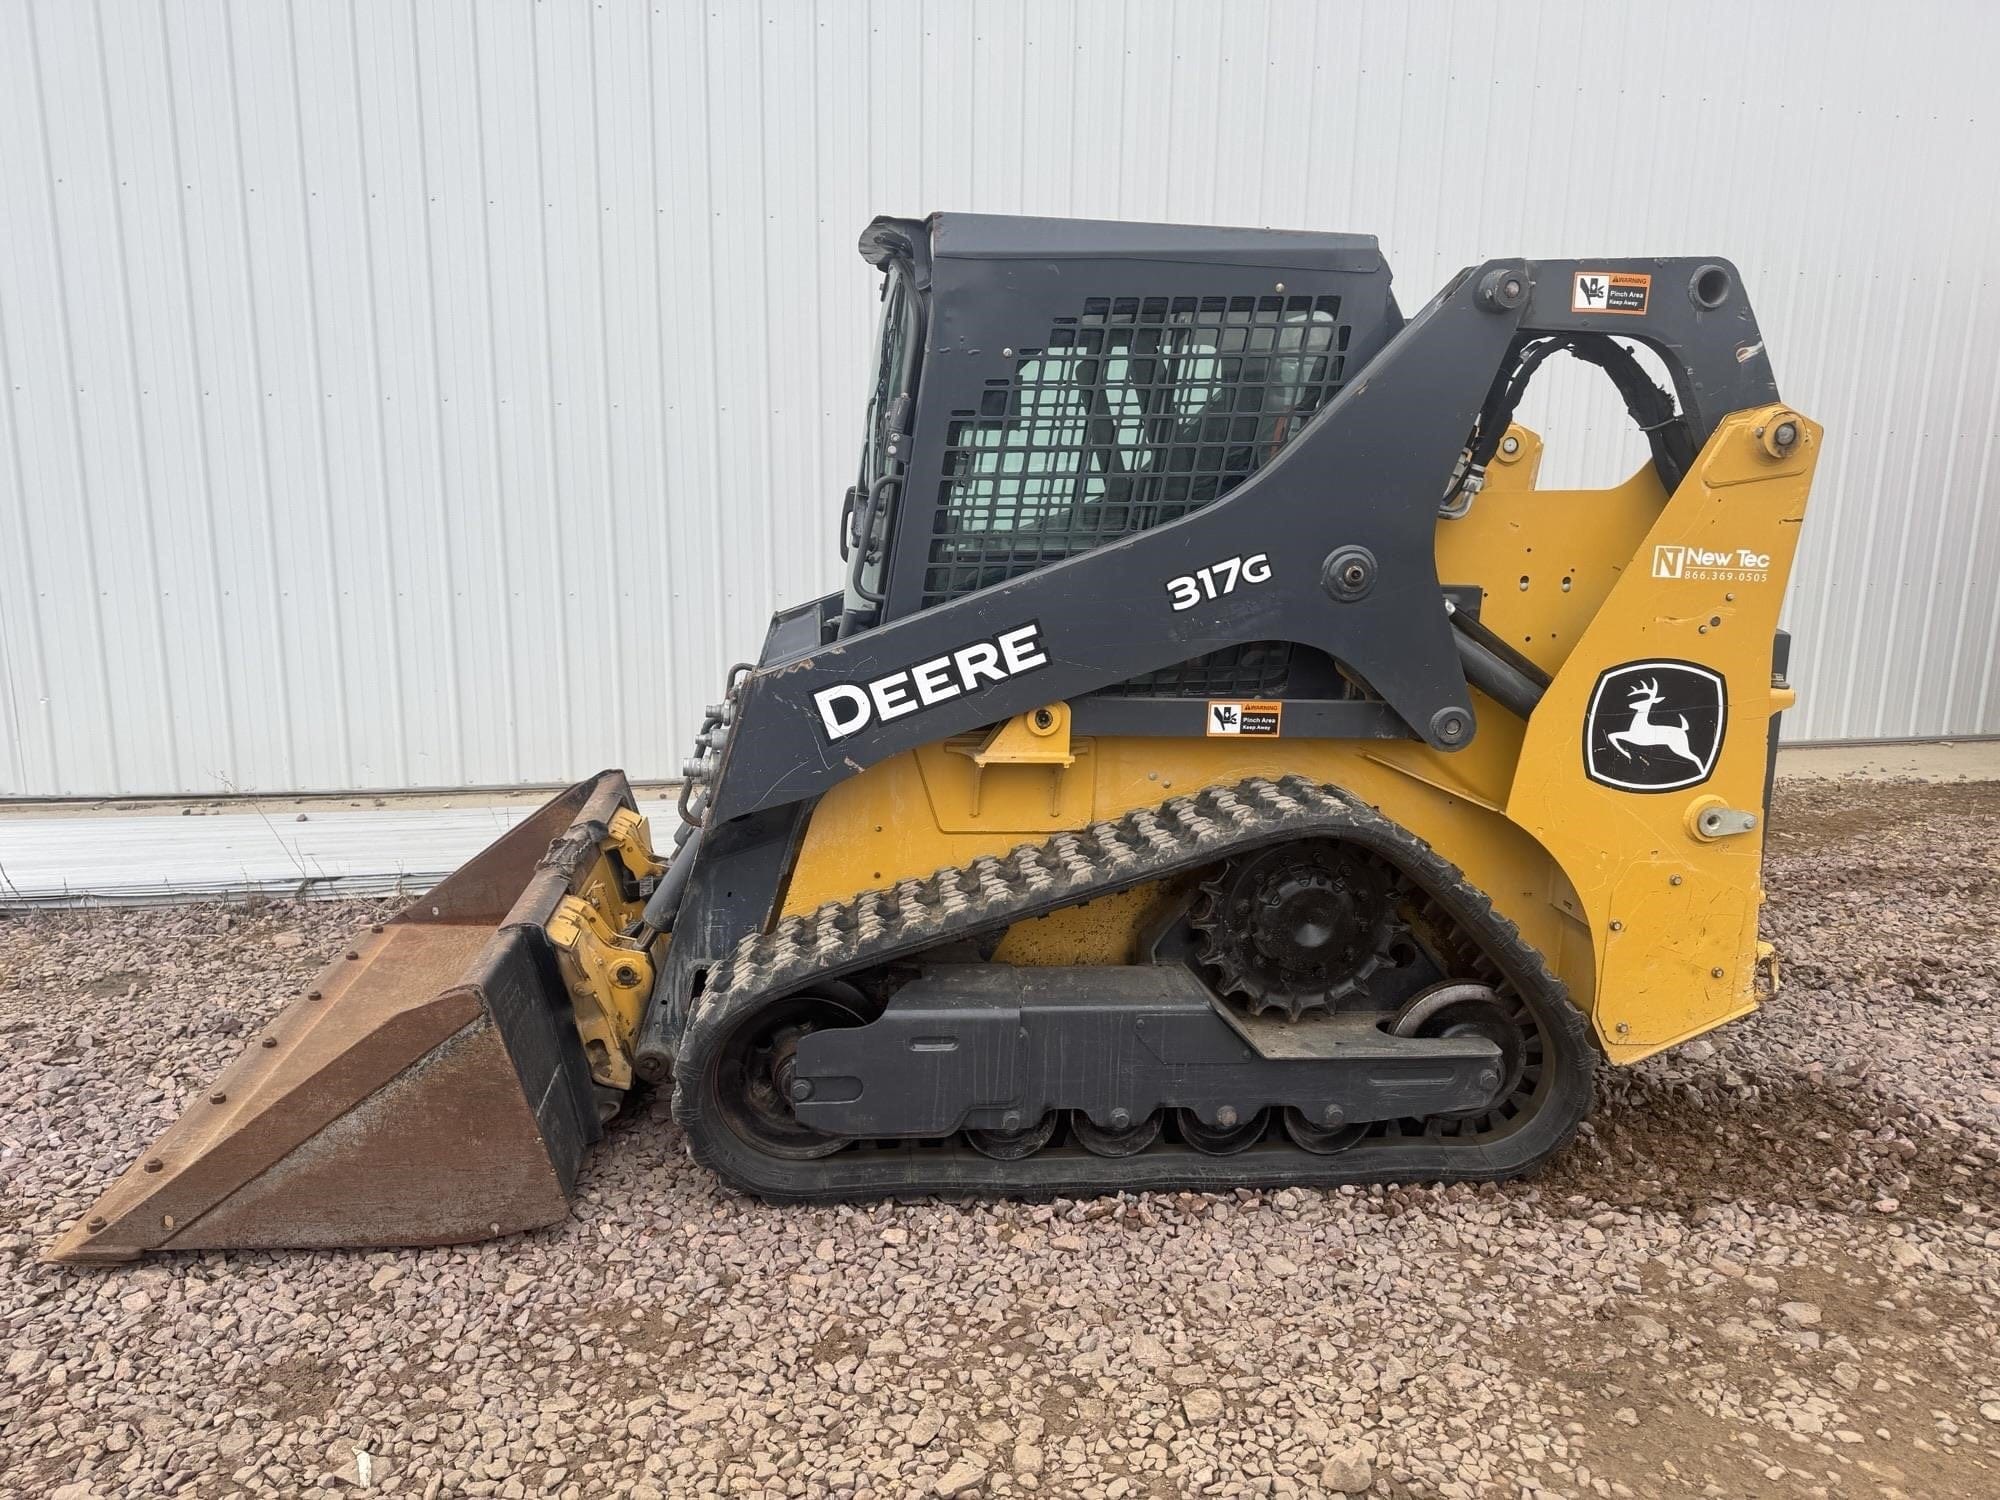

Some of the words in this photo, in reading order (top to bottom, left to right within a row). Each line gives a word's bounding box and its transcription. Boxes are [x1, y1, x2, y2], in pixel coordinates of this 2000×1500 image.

[1610, 290, 1628, 298] Pinch
[1629, 291, 1644, 299] Area
[1686, 547, 1732, 566] New
[1736, 549, 1770, 568] Tec
[1166, 553, 1272, 611] 317G
[1684, 571, 1768, 582] 866.369.0505
[814, 624, 1047, 740] DEERE
